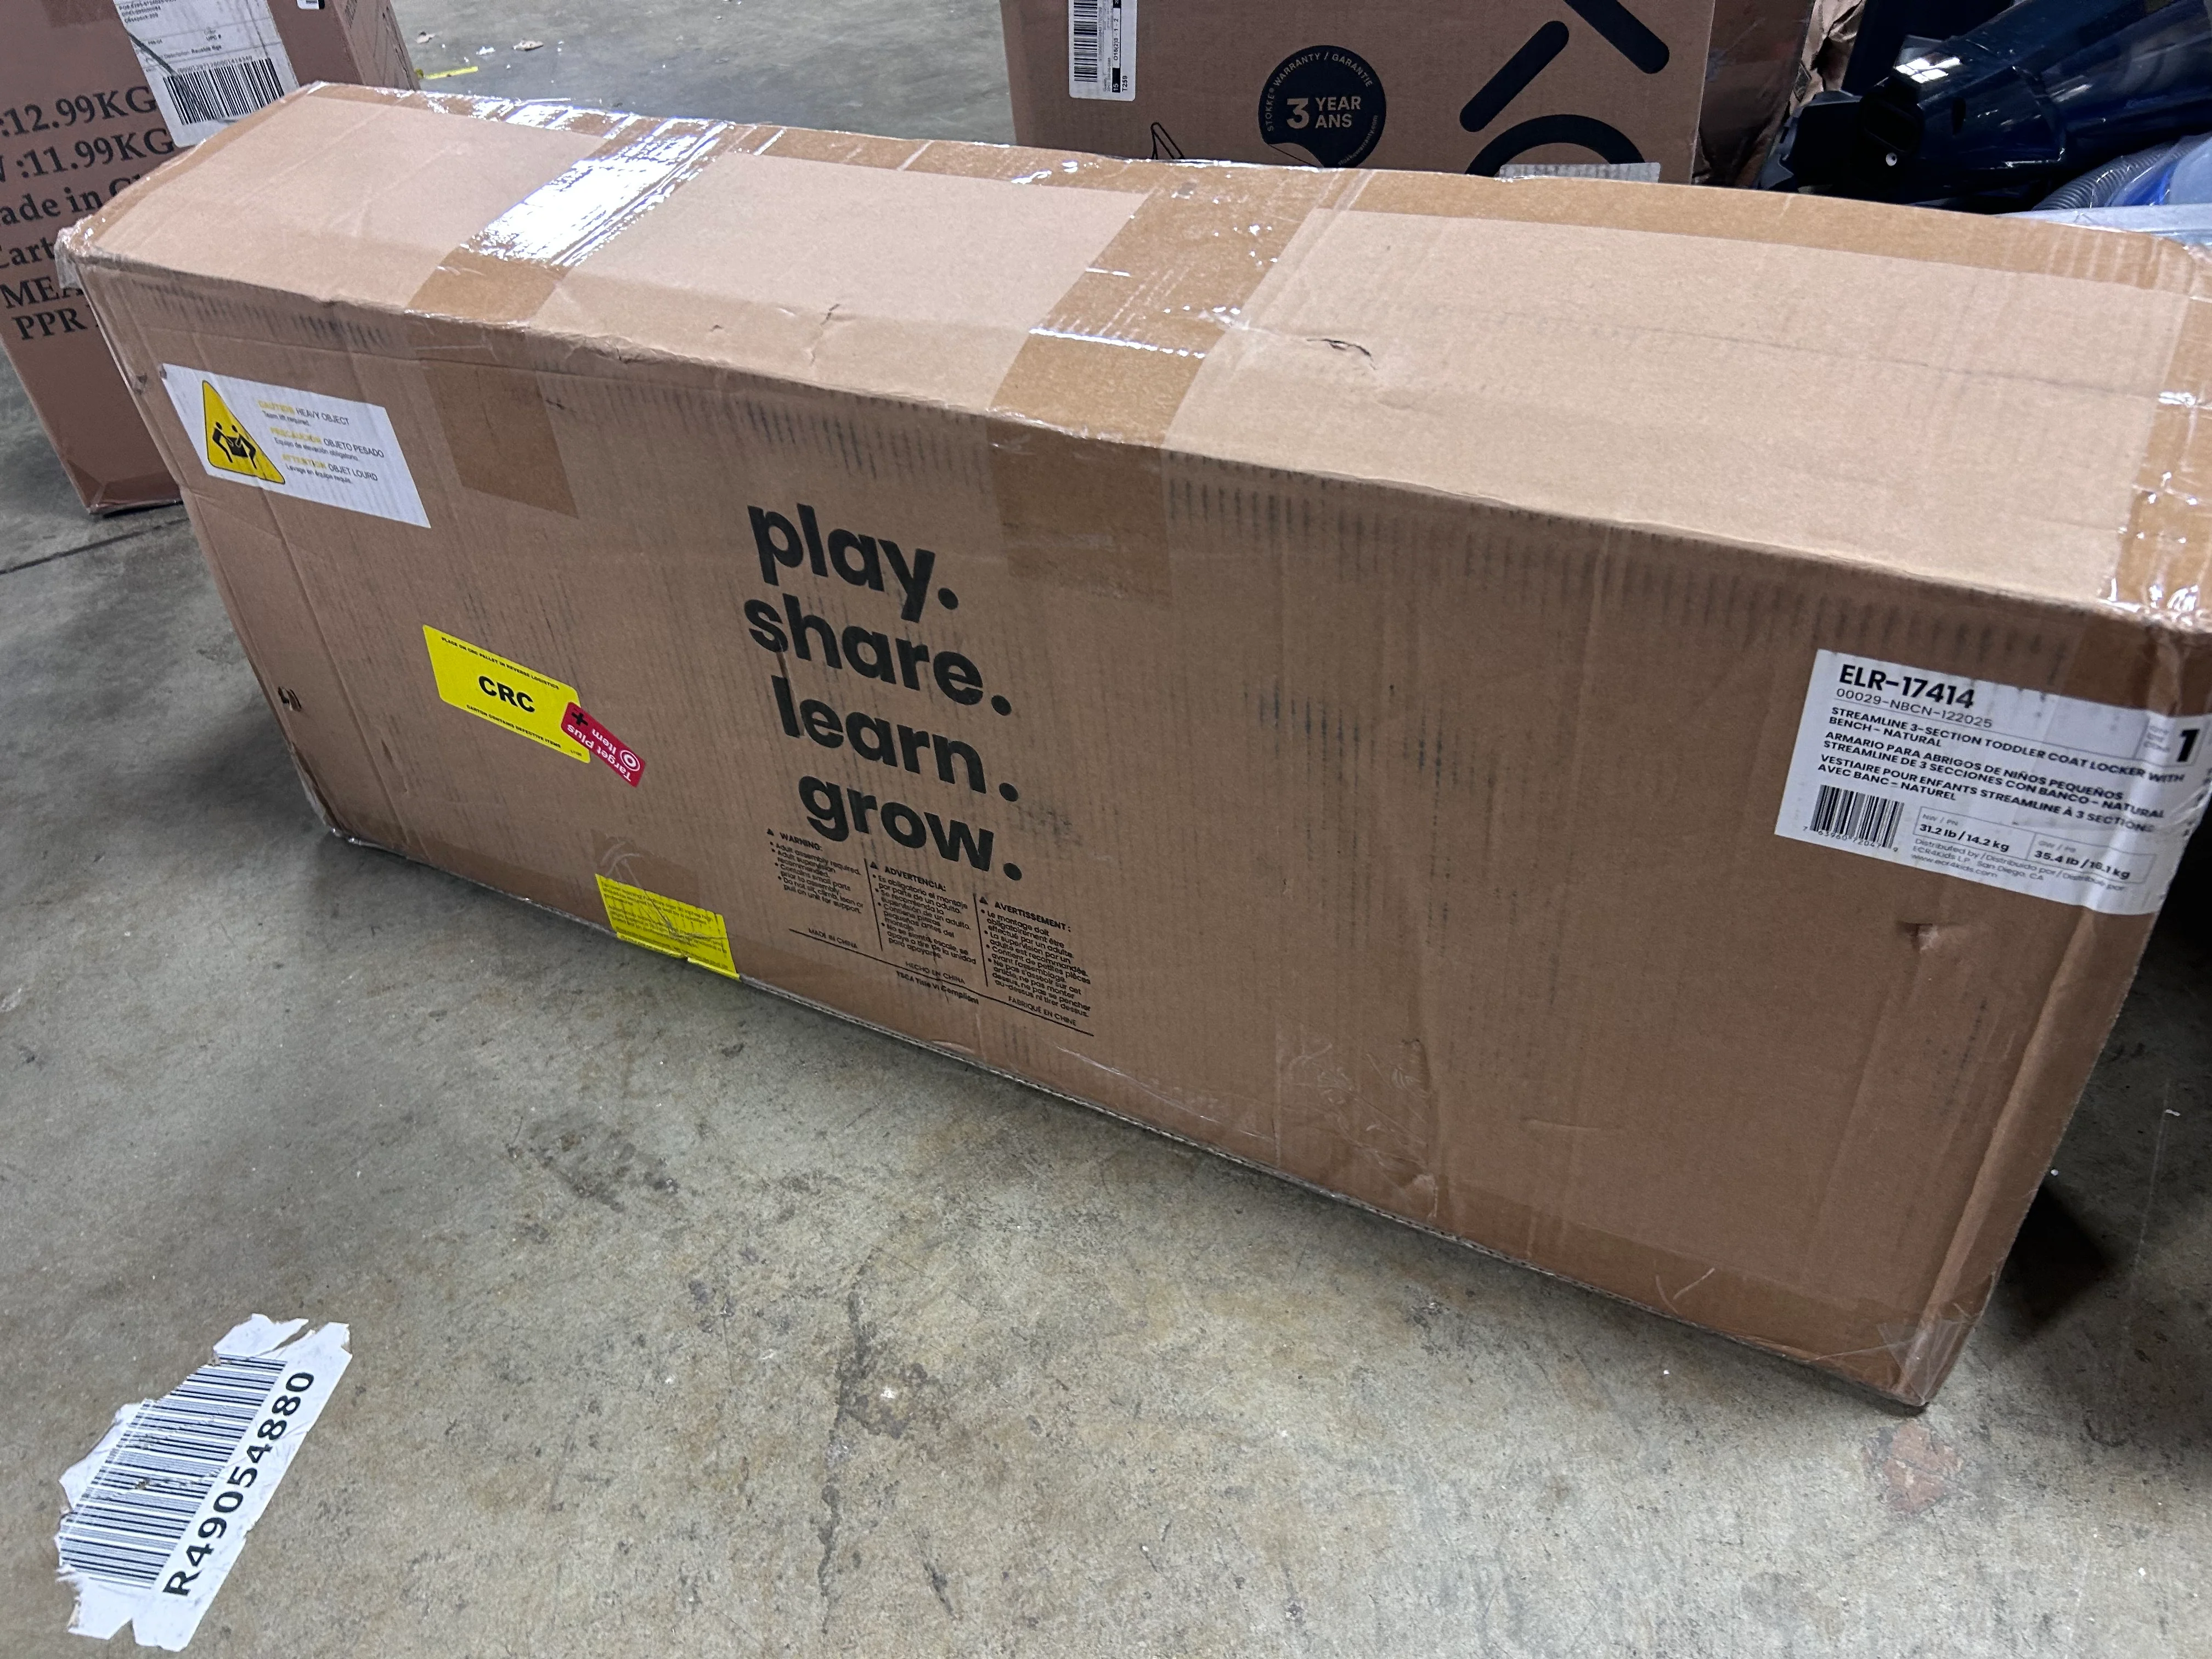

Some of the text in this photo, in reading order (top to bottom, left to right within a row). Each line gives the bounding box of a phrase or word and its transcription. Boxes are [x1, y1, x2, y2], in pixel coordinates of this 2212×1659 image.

[1273, 53, 1320, 86] WARRANTY
[1332, 54, 1373, 87] GARANTIE
[1286, 98, 1310, 129] 3
[1316, 97, 1361, 111] YEAR
[1315, 114, 1352, 128] ANS
[64, 187, 103, 213] in
[12, 307, 87, 340] PPR
[296, 408, 349, 425] HEAVY OBJECT
[324, 438, 383, 458] OBJETO PESADO
[328, 464, 377, 481] OBJET LOURD
[747, 503, 958, 624] play.
[743, 592, 1012, 716] share.
[479, 652, 498, 664] PALLET
[506, 664, 530, 678] REVERSE
[531, 674, 560, 690] LOGISTICS
[1838, 664, 1977, 709] ELR-17414
[478, 675, 535, 713] CRC
[1835, 688, 1994, 729] 00029-NBCN-122025
[488, 713, 515, 728] CONTAINS
[545, 737, 561, 748] ITEMS
[592, 728, 616, 755] Item
[771, 674, 1019, 802] learn.
[1829, 716, 1942, 747] BENCH NATURAL
[1830, 707, 2185, 783] STREAMLINE 3-SECTION TODDLER COAT LOCKER WITH
[2177, 729, 2200, 762] 1
[567, 724, 631, 782] Target Plus
[1825, 731, 2124, 802] ARMARIO PARA ABRIGOS DE NIÑOS PEQUEÑOS
[1818, 764, 1957, 800] AVEC BANC NATUREL
[1820, 754, 1881, 774] VESTIAIRE
[1882, 768, 1918, 782] POUR
[1919, 776, 1978, 795] ENFANTS
[1979, 789, 2061, 814] STREAMLINE
[2063, 805, 2074, 816] À
[2075, 810, 2084, 819] 3
[1822, 741, 2165, 820] STREAMLINE DE 3 SECCIONES CON BANCO NATURAL
[799, 775, 1022, 881] grow.
[1919, 823, 1942, 835] 31.2
[1943, 829, 1956, 838] lb
[1966, 834, 1991, 847] 14.2
[1992, 840, 2010, 852] kg
[883, 865, 946, 892] ADVERTENCIA:
[2034, 850, 2062, 863] 35.4
[2066, 856, 2079, 866] lb
[2111, 867, 2131, 880] kg
[878, 882, 890, 892] por
[994, 900, 1066, 930] AVERTISSEMENT
[997, 914, 1032, 932] montage
[1020, 936, 1034, 946] par
[905, 961, 930, 974] HECHO
[943, 972, 966, 985] CHINA
[162, 1372, 314, 1596] R49054880
